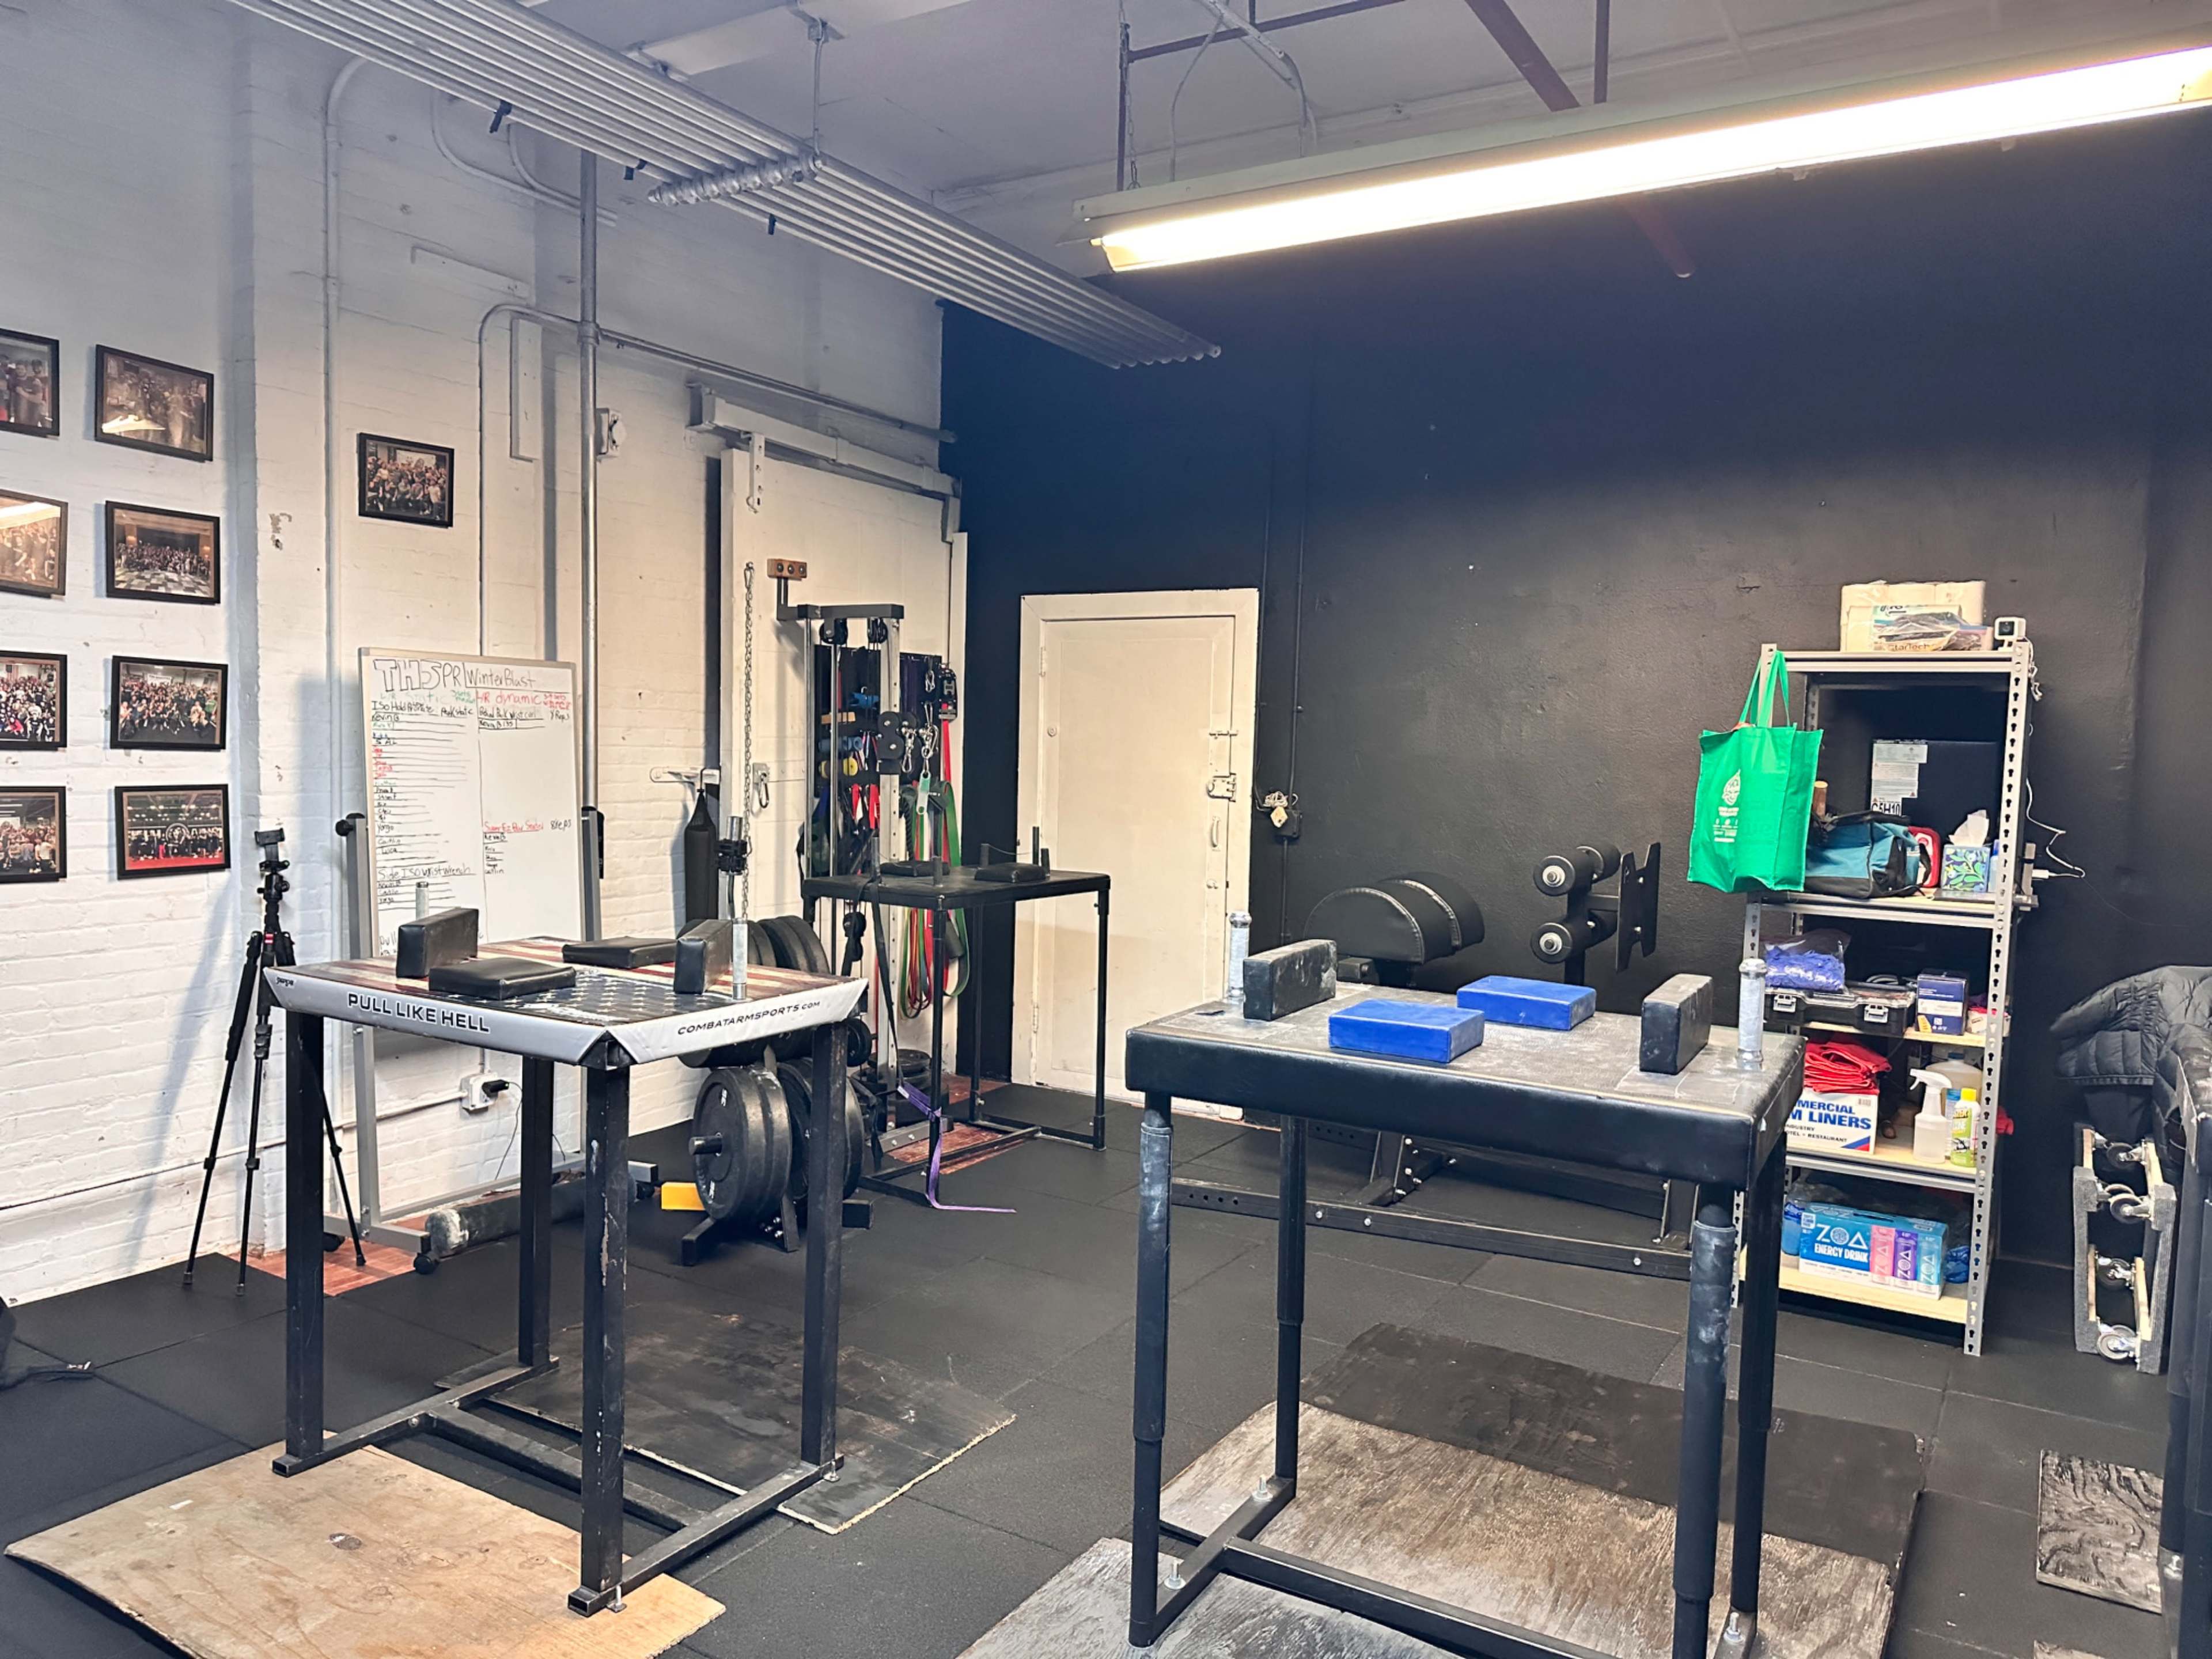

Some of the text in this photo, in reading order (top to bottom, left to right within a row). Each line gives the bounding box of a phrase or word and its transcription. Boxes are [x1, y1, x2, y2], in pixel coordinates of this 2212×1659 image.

[348, 993, 490, 1033] PULL LIKE HELL
[1808, 1110, 1872, 1130] LINERS
[1808, 1133, 1847, 1142] RESTAURANT
[1816, 1223, 1869, 1250] ZOA
[1814, 1243, 1869, 1263] ENERGY DRINK
[1897, 1249, 1911, 1279] ZOA
[1920, 1253, 1936, 1285] ZOA
